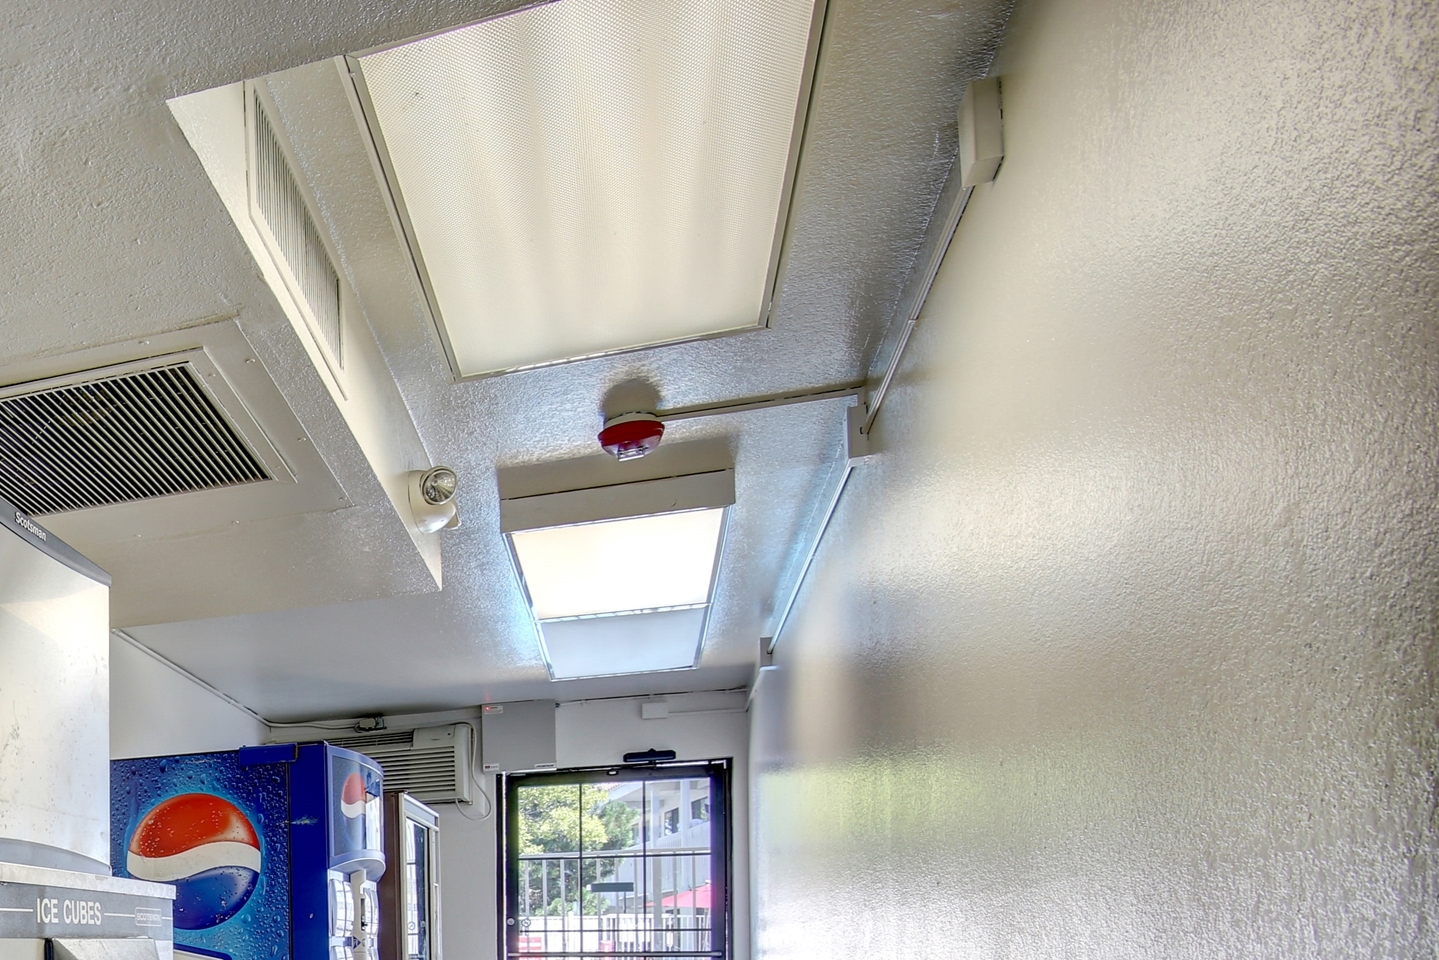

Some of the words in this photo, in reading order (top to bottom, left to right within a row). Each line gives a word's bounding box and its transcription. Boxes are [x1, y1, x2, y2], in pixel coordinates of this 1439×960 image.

[15, 511, 47, 542] Scotsman
[36, 898, 59, 924] ICE
[63, 899, 102, 926] CUBES
